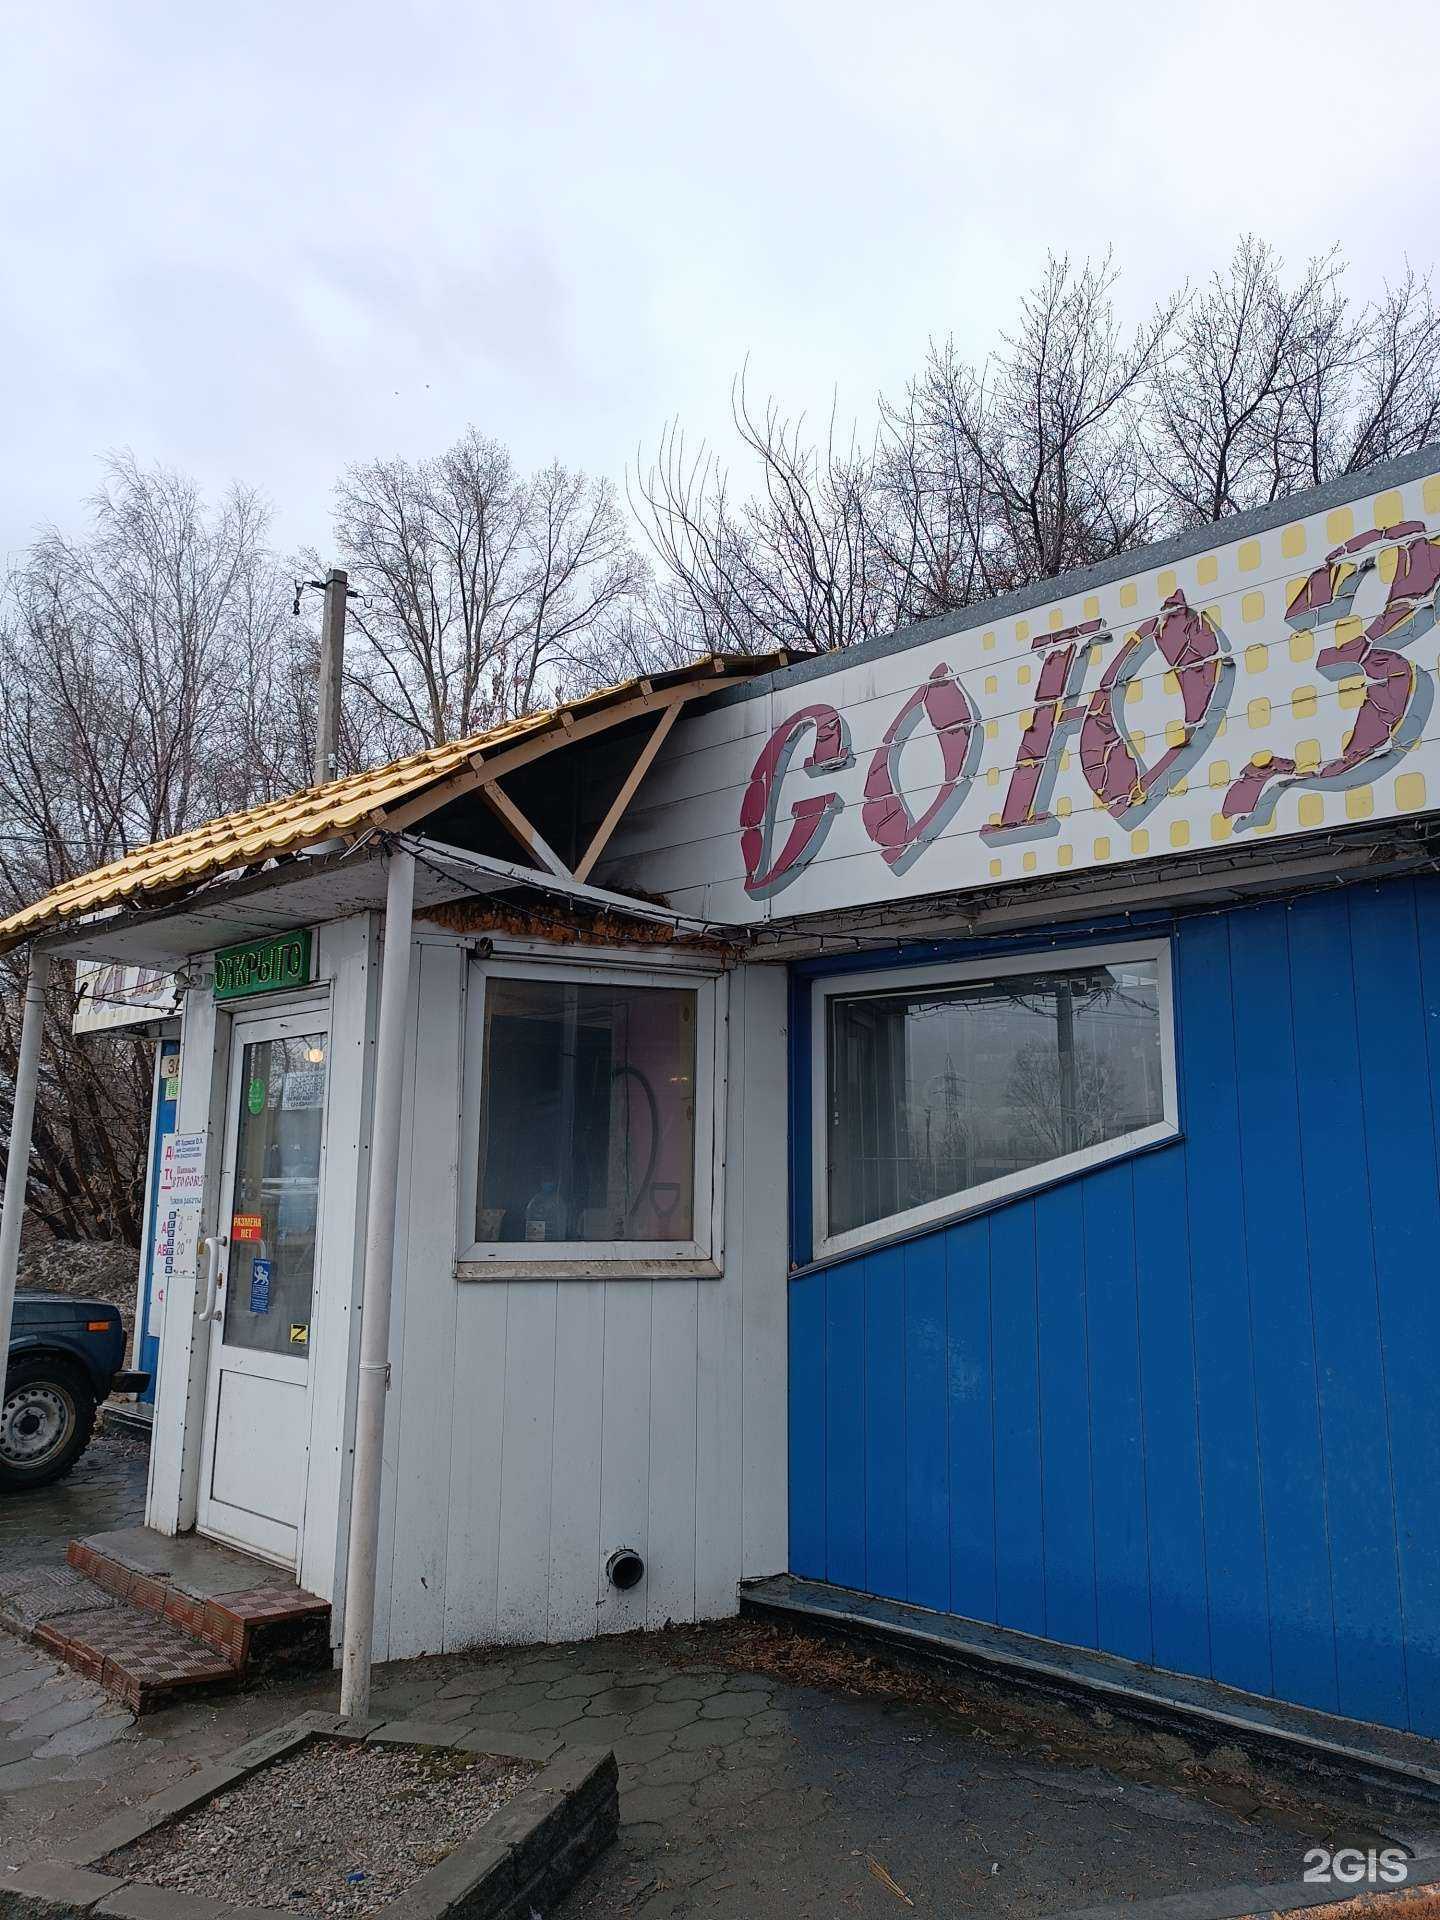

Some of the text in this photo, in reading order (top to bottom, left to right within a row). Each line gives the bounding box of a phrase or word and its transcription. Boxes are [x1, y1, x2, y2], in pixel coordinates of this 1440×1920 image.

[740, 519, 1440, 902] СОЮЗ
[215, 941, 302, 992] ОТКРЫТО
[233, 1215, 262, 1228] РАЗМЕНА
[240, 1228, 253, 1238] НЕТ
[291, 1324, 308, 1343] Z
